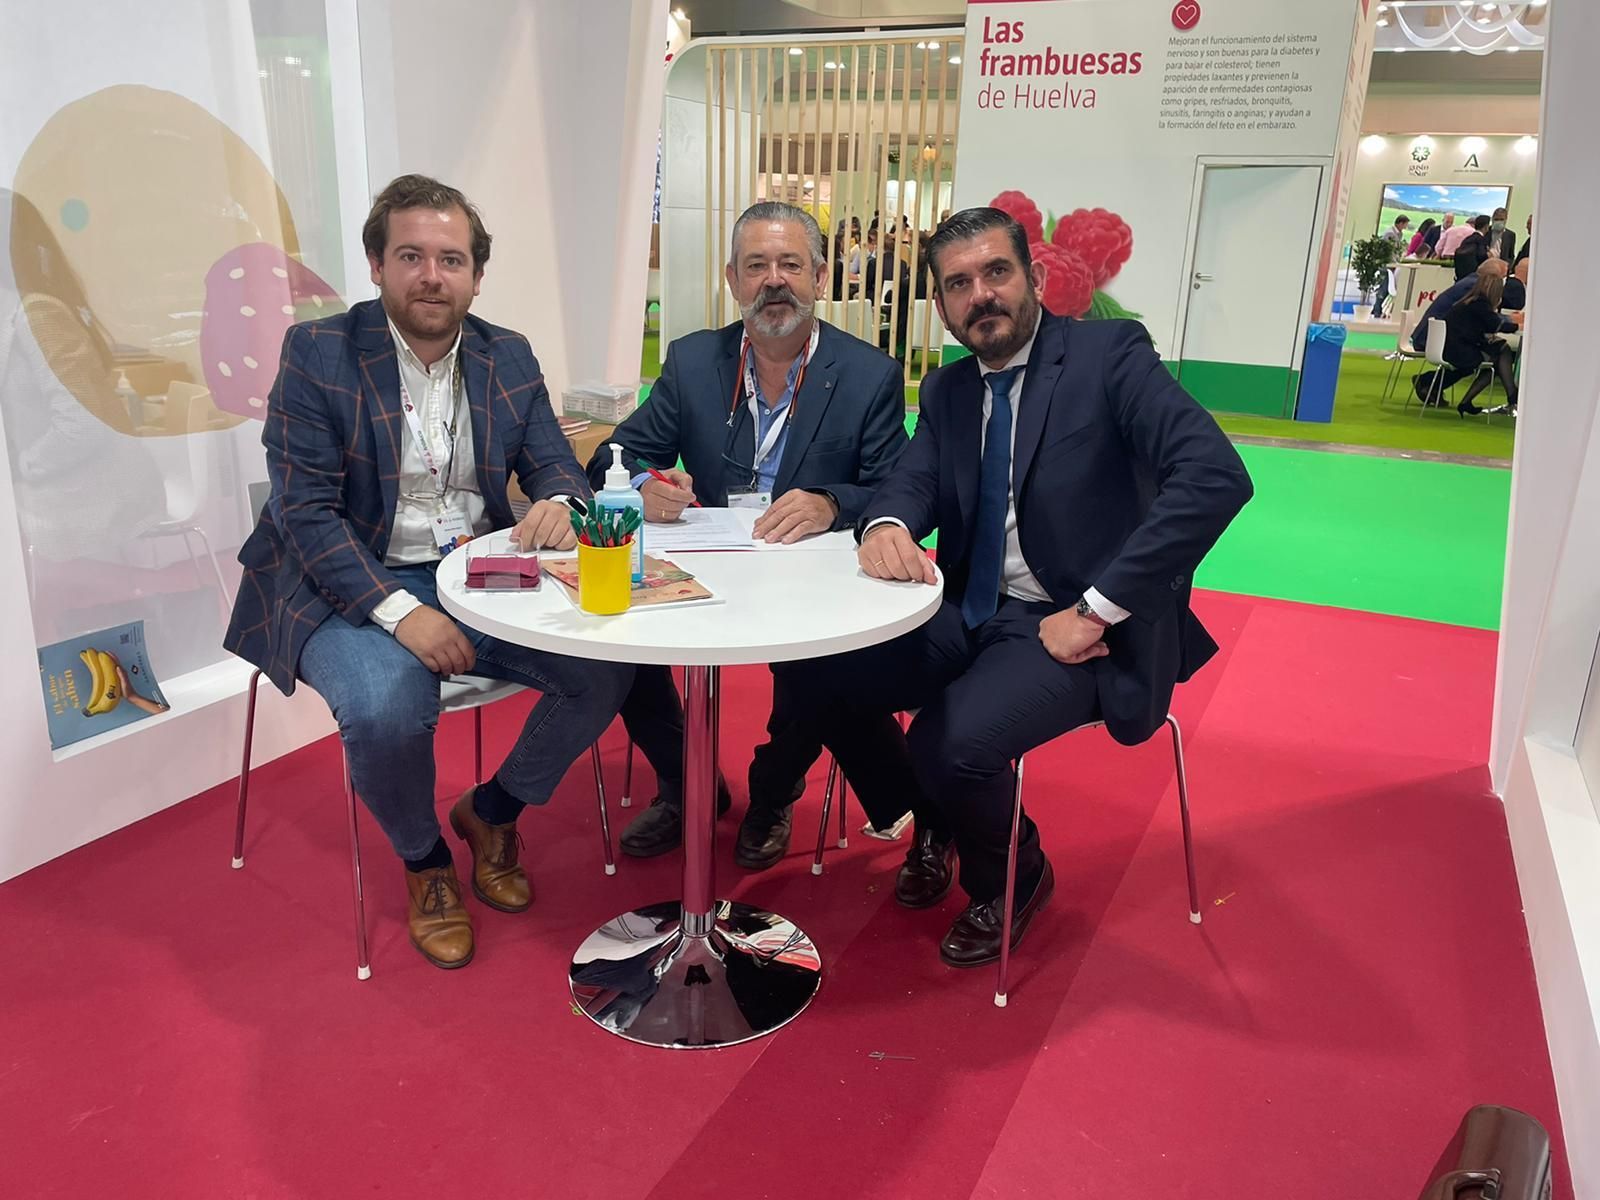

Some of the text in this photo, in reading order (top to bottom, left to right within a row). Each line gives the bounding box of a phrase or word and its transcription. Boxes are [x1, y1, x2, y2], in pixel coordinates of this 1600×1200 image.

[983, 16, 1024, 43] Las
[1168, 33, 1317, 46] Mejoran el funcionamiento del sistema
[1167, 49, 1199, 57] nervioso
[1200, 50, 1205, 58] y
[1221, 48, 1249, 57] buenas
[1250, 49, 1269, 57] para
[1271, 47, 1278, 55] la
[1280, 46, 1314, 55] diabetes
[1315, 47, 1320, 56] y
[980, 46, 1142, 76] frambuesas
[1165, 62, 1182, 71] para
[1184, 61, 1204, 70] bajar
[1205, 60, 1213, 69] el
[1164, 71, 1299, 82] propiedades laxantes y previenen la
[1162, 84, 1313, 94] aparición de enfermedades contagiosas
[978, 82, 1096, 109] de Huelva
[1183, 97, 1208, 107] gripes,
[1210, 97, 1249, 106] resfriados,
[1192, 108, 1225, 119] faringitis
[1268, 110, 1273, 118] y
[1274, 108, 1304, 118] ayudan
[1158, 120, 1165, 129] la
[1167, 120, 1204, 129] formación
[1206, 120, 1218, 129] del
[1219, 120, 1235, 129] feto
[1248, 121, 1255, 129] el
